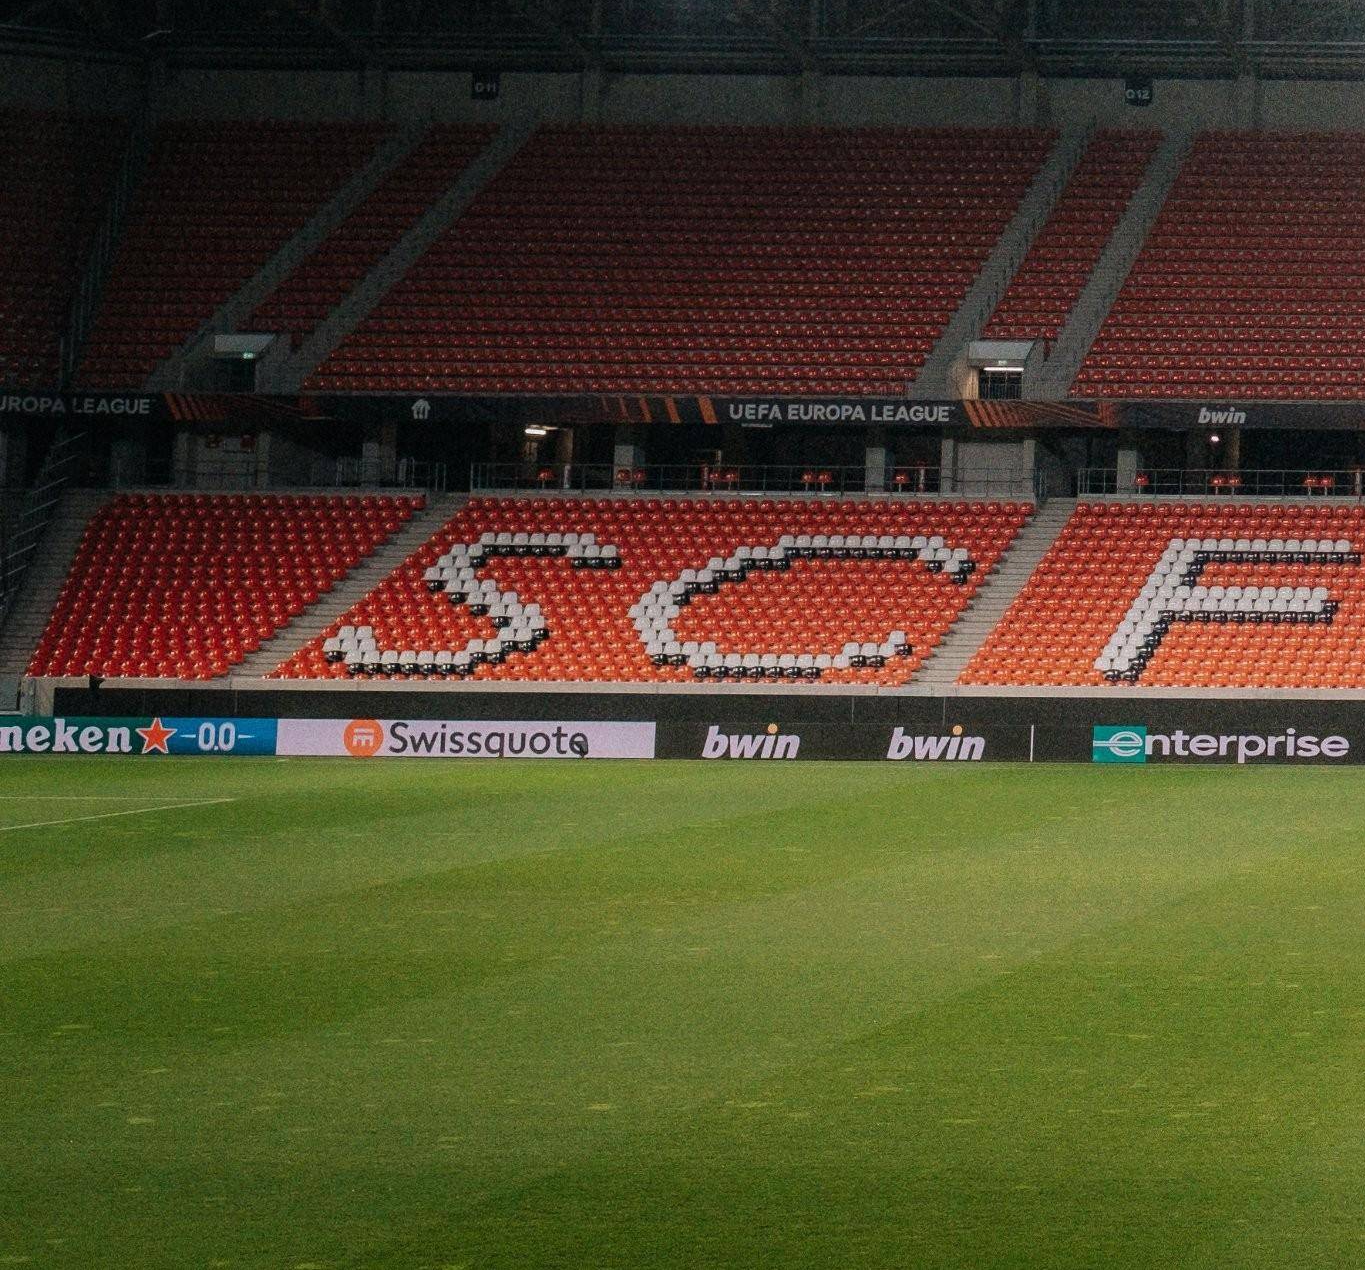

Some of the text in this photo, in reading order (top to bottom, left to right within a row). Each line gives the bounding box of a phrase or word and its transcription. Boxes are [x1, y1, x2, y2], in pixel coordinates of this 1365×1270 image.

[72, 398, 151, 414] LEAGUE
[729, 404, 950, 422] UEFA EUROPA LEAGUE
[1197, 407, 1247, 424] bwin
[325, 532, 978, 682] SC
[388, 723, 589, 757] Swissquote
[701, 723, 800, 759] bwin
[886, 725, 985, 761] bwin
[1103, 727, 1350, 762] enterprise
